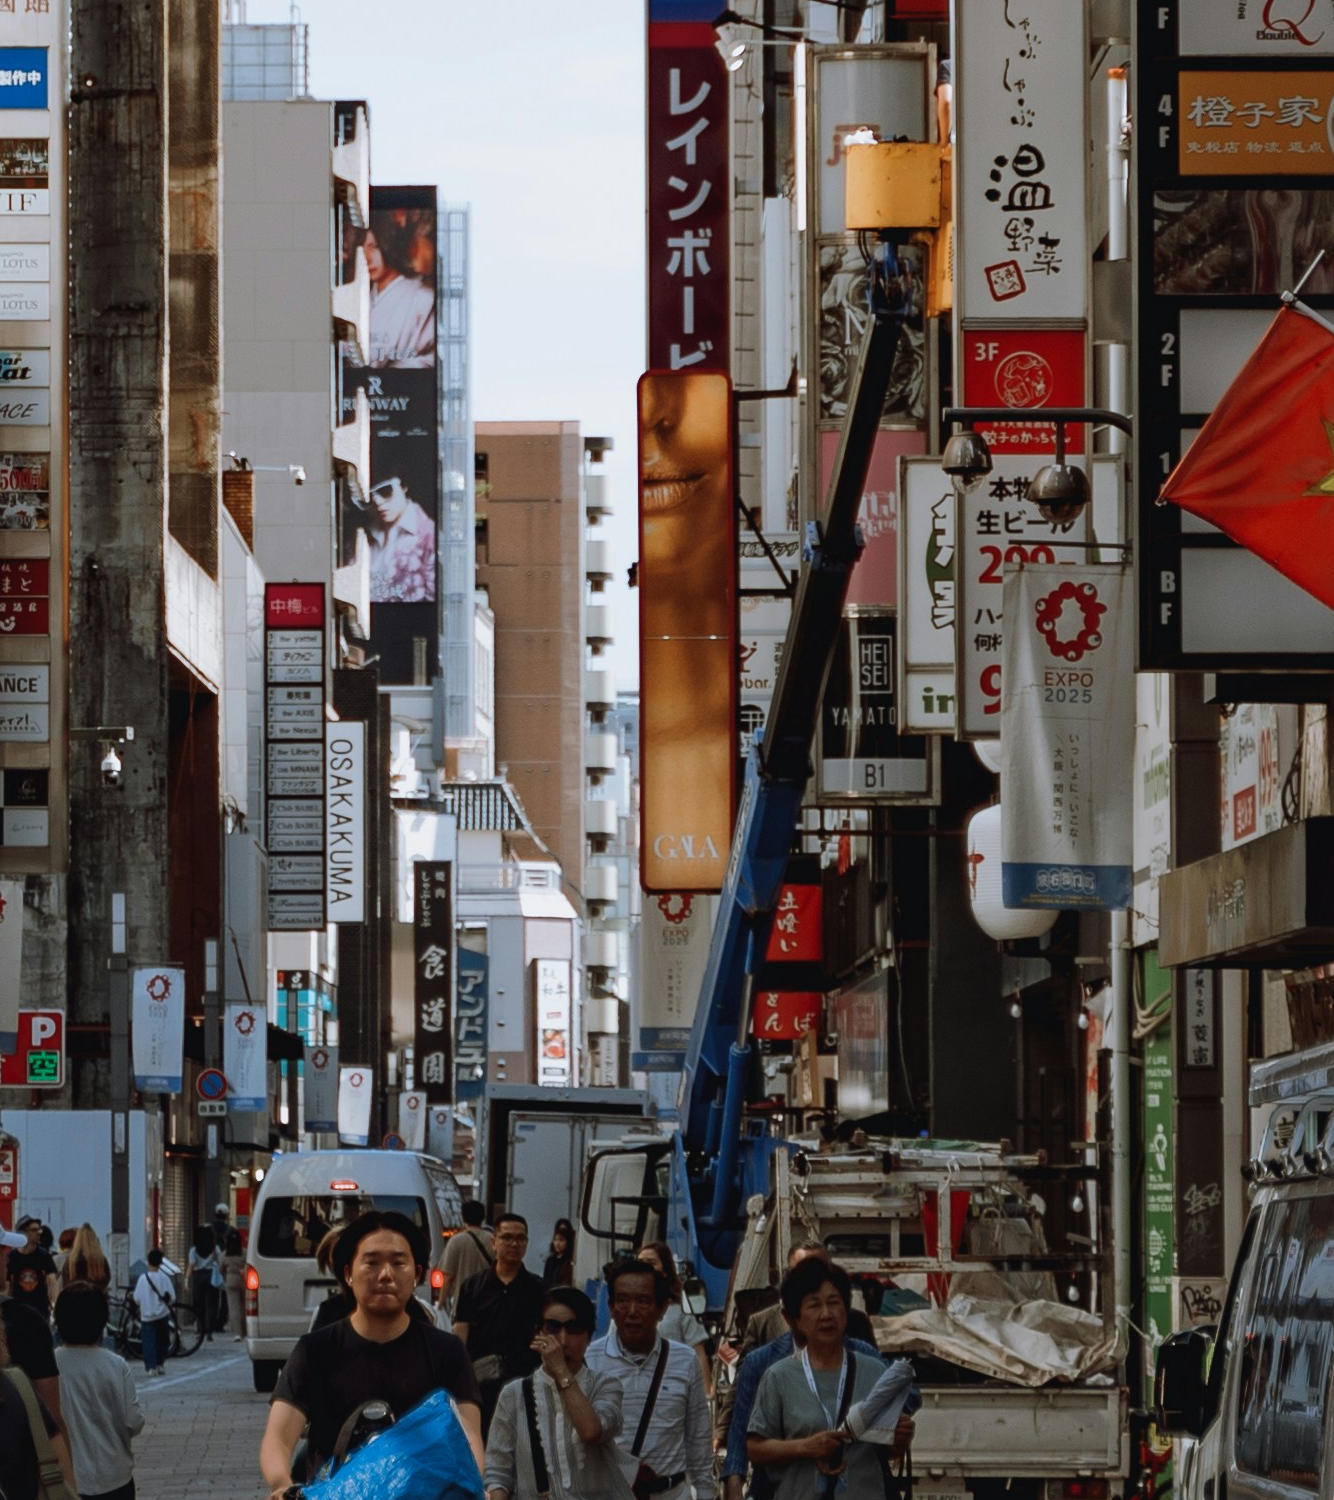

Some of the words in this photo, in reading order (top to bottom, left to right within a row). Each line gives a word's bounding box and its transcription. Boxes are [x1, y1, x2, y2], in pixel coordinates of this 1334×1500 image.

[1186, 95, 1325, 129] 橙子家
[984, 143, 1063, 276] 温野菜
[974, 342, 999, 362] 3F
[861, 643, 889, 664] HEI
[861, 665, 889, 687] SEI
[1043, 671, 1095, 688] EXPO
[1044, 688, 1093, 704] 2025
[831, 705, 897, 726] YAMATO
[864, 763, 885, 789] B1
[329, 738, 353, 904] OSAKAKUMA
[31, 1016, 57, 1047] P
